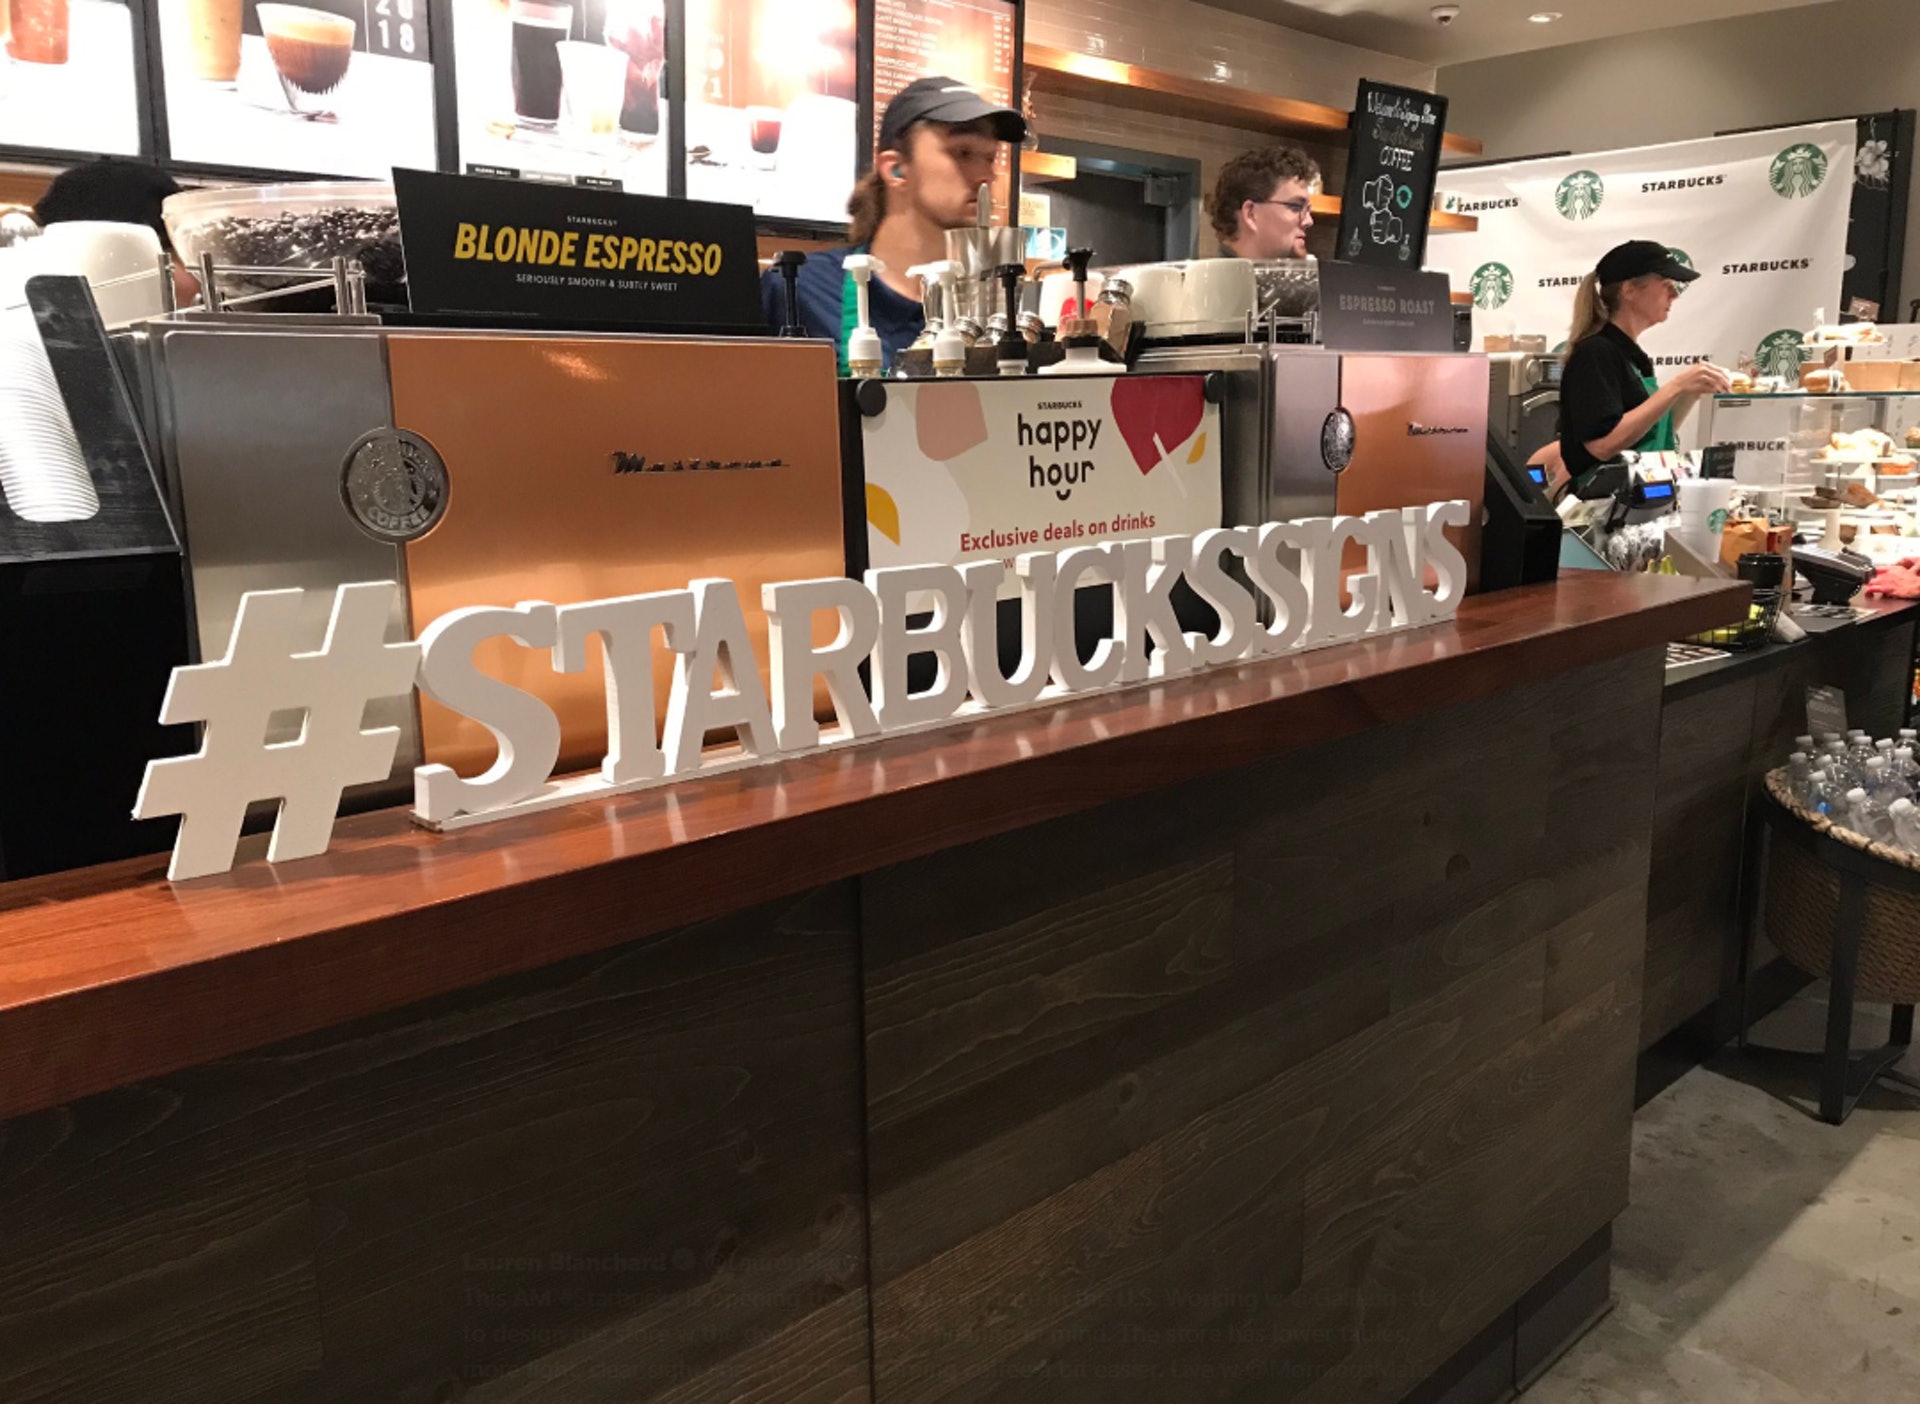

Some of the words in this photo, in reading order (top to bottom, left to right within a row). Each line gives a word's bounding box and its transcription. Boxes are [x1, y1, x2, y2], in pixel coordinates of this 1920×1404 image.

[378, 19, 415, 53] 18
[1641, 174, 1724, 193] STARBUCKS
[1458, 197, 1519, 212] TARBUCKS
[454, 222, 580, 268] BLONDE
[584, 233, 723, 277] ESPRESSO
[1721, 258, 1809, 275] STARBUCKS
[515, 273, 565, 285] SERIOUSLY
[567, 277, 606, 288] SMOOTH
[608, 280, 615, 288] &
[617, 280, 648, 290] SUBTLY
[650, 283, 678, 292] SWEET
[1339, 293, 1396, 313] ESPRESSO
[1400, 298, 1435, 315] ROAST
[1037, 401, 1082, 411] STARBUCKS
[1017, 412, 1102, 452] happy
[1029, 455, 1095, 488] hour
[960, 526, 1039, 552] Exclusive
[1043, 519, 1084, 542] deals
[1088, 519, 1108, 536] on
[1111, 511, 1156, 533] drinks
[131, 499, 1471, 881] #STARBUCKSSIGNS
